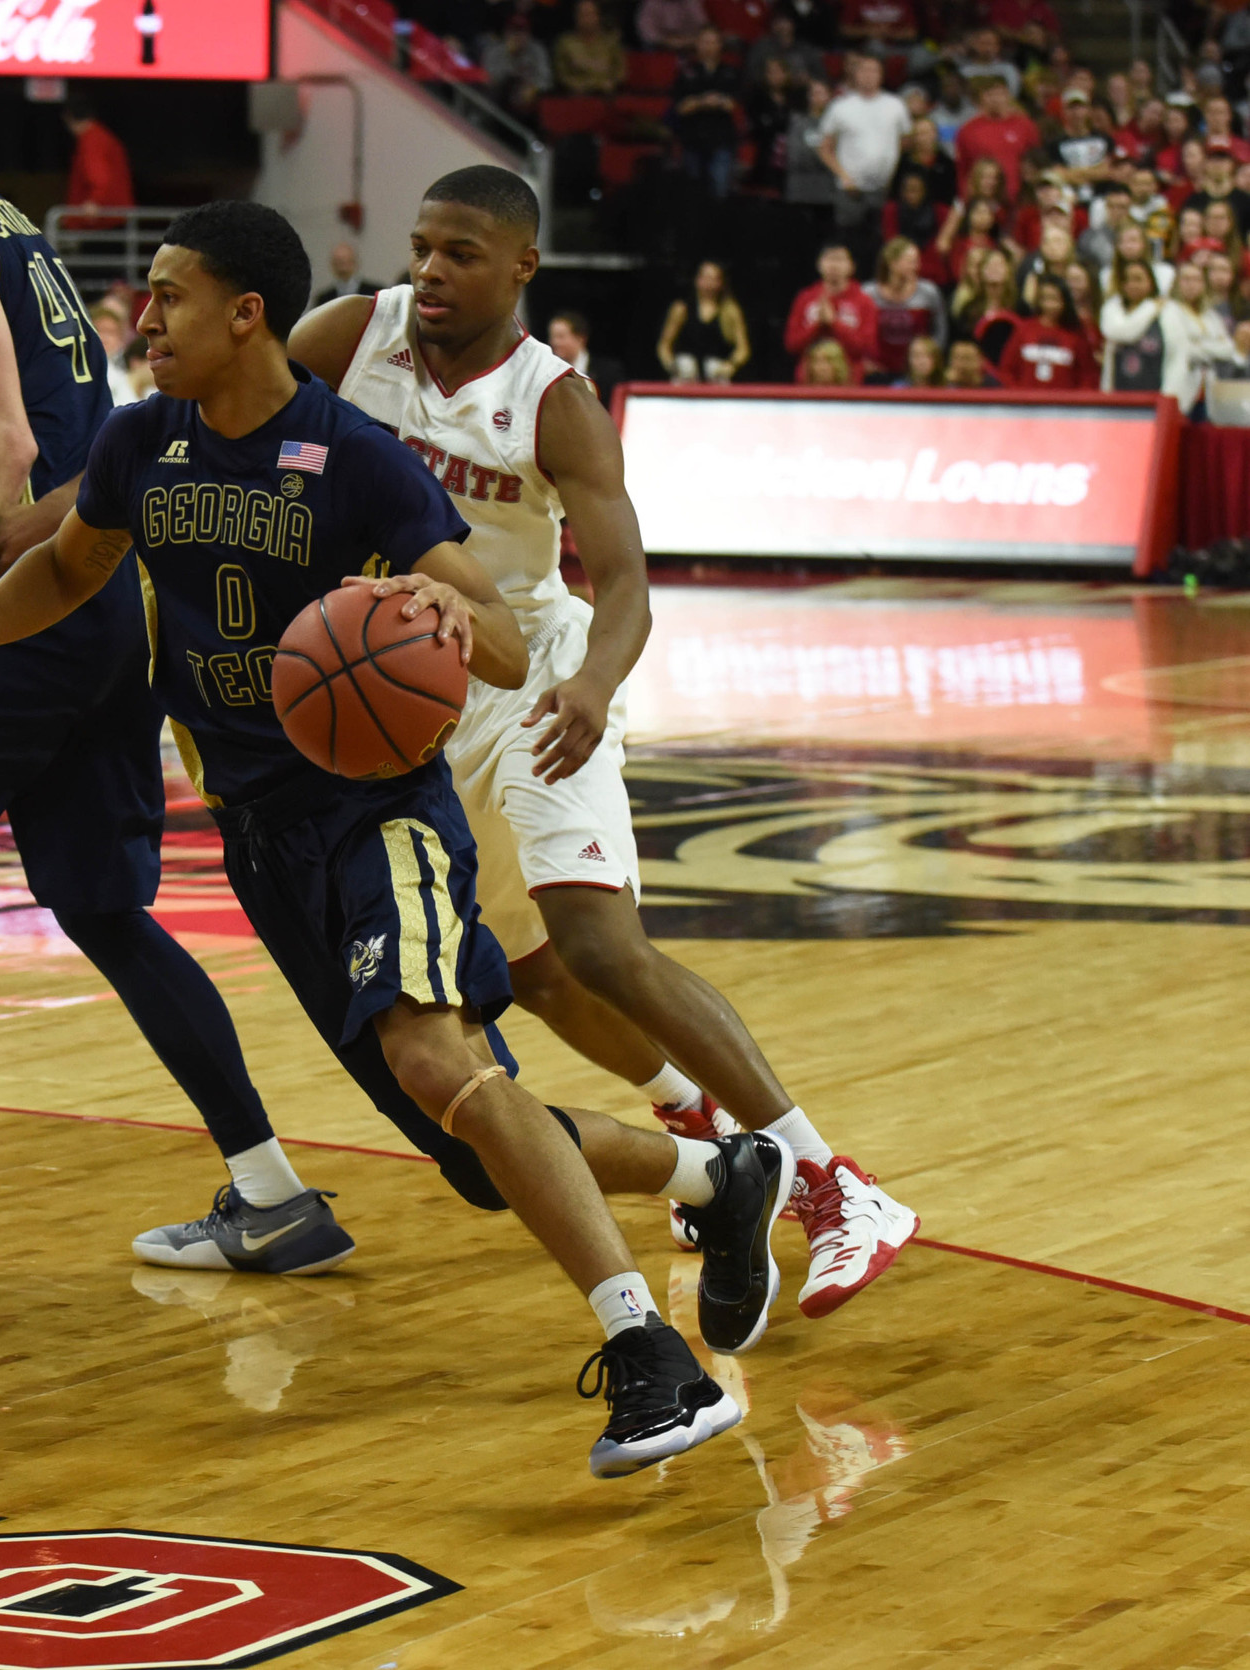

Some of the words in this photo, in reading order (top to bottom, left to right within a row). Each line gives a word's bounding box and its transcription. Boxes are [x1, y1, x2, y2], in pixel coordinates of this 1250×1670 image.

[387, 357, 415, 373] adidas
[157, 456, 190, 464] RUSSELL
[907, 449, 1089, 506] Loans
[143, 482, 312, 567] GEORGIA
[216, 563, 256, 640] 0
[186, 645, 278, 708] TEC
[577, 851, 607, 864] adidas
